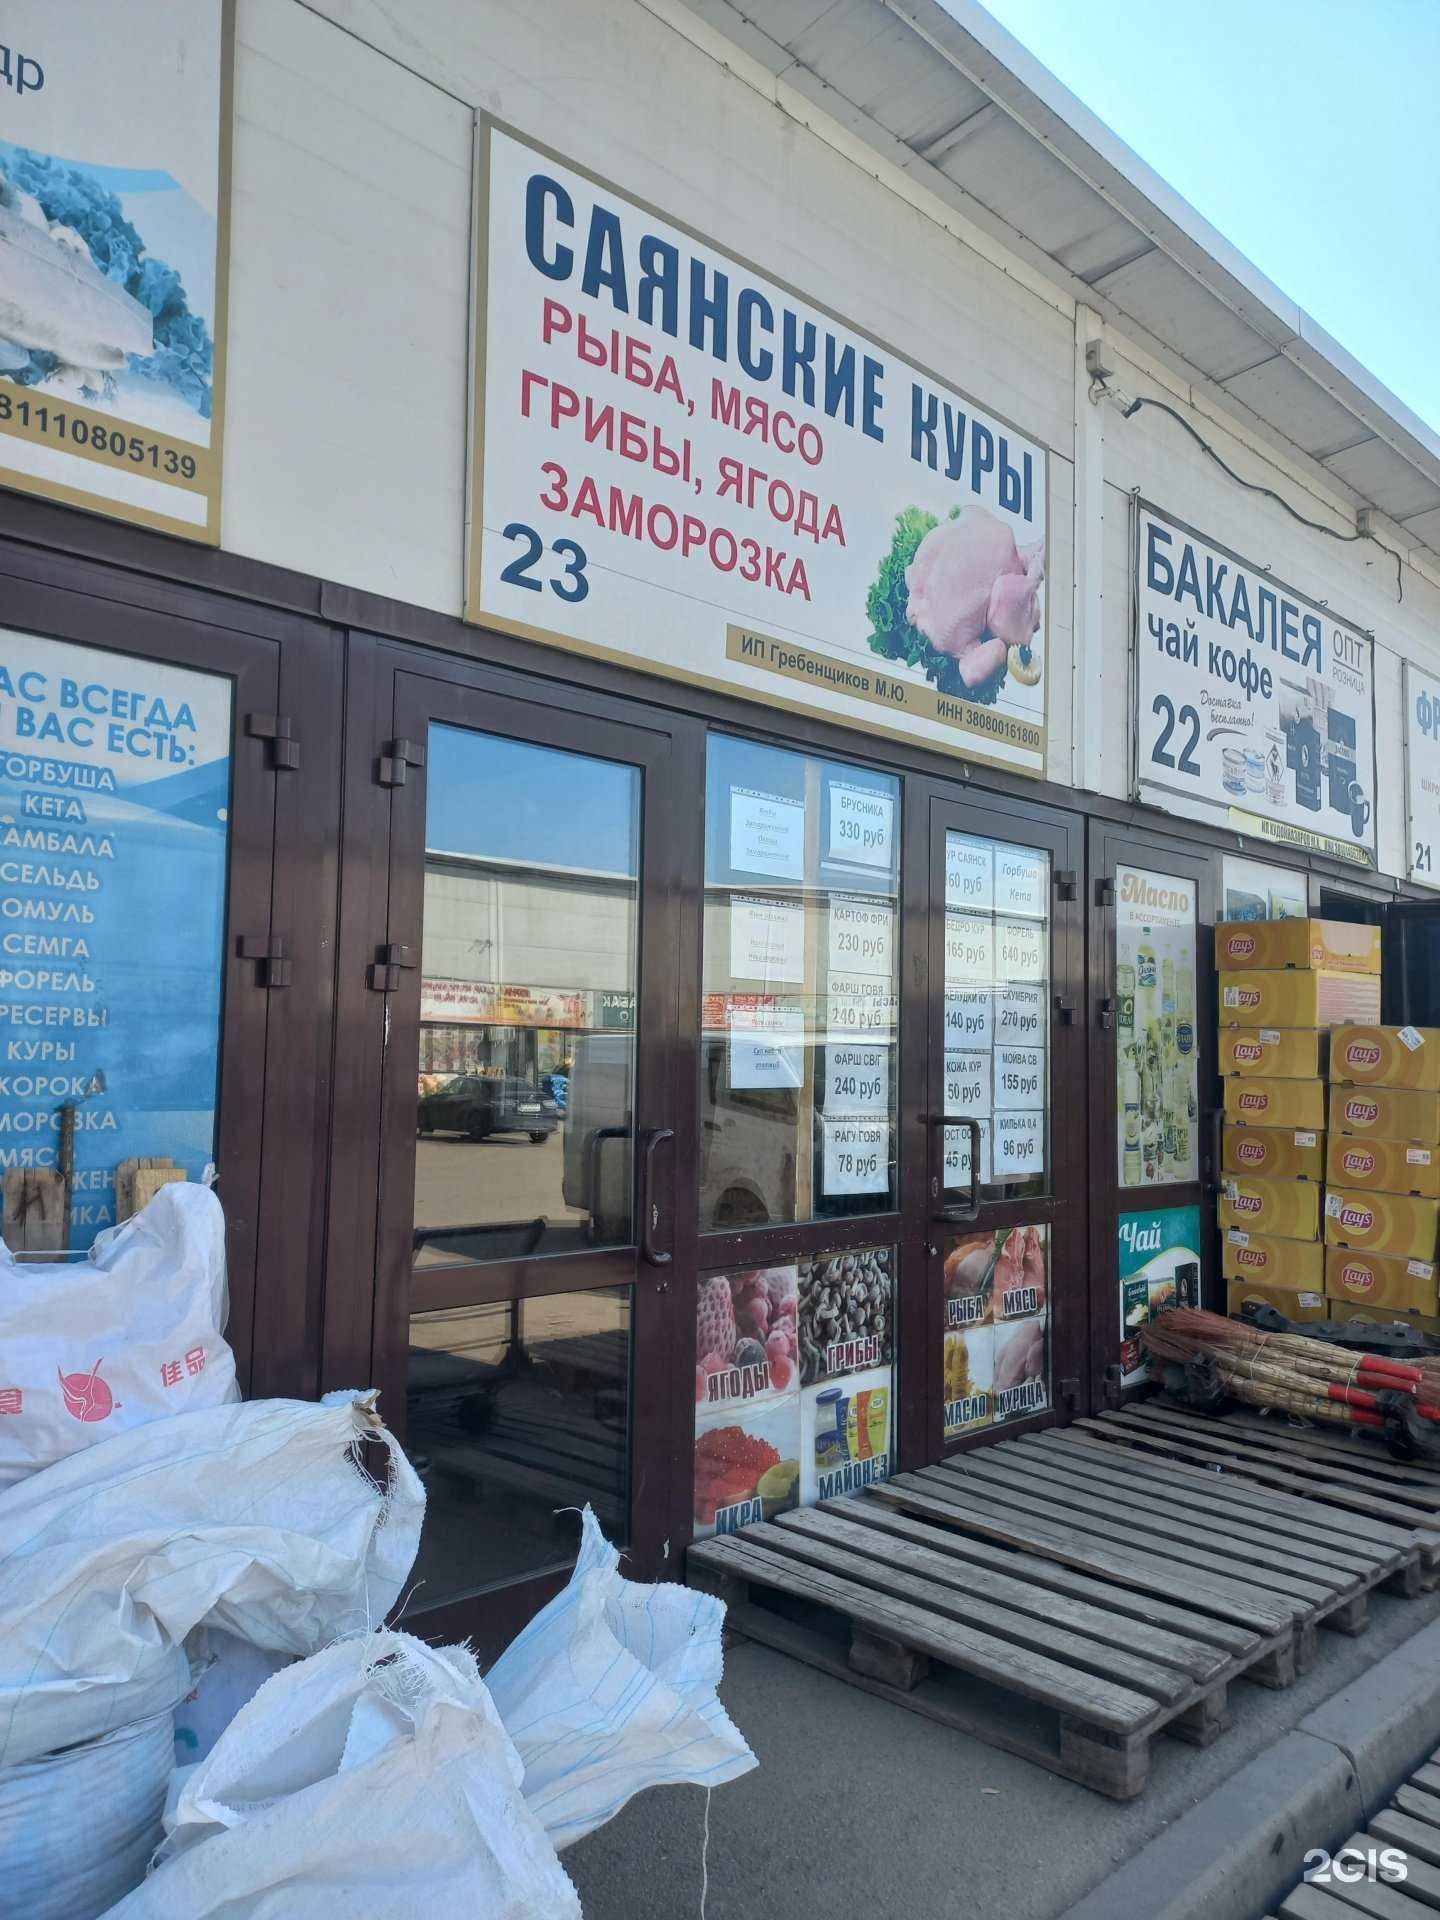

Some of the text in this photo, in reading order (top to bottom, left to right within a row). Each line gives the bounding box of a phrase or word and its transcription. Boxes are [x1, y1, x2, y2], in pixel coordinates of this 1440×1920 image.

[524, 173, 1034, 523] САЯНСКИЕ КУРЫ
[543, 297, 825, 466] РЫБА, МЯСО
[521, 368, 847, 547] ГРИБЫ, ЯГОДА
[539, 461, 812, 602] ЗАМОРОЗКА
[500, 522, 590, 602] 23
[1146, 522, 1322, 674] БАКАЛЕЯ
[1148, 612, 1273, 701] чай кофе
[1333, 629, 1364, 669] ОПТ
[742, 634, 908, 704] ИП Гребенщиков М.Ю.
[1332, 666, 1366, 696] РОЗНИЦА
[59, 678, 197, 732] ВСЕГДА
[937, 699, 963, 722] ИНН
[1200, 689, 1242, 710] Доставка
[15, 706, 196, 766] ВАС ЕСТЬ:
[1151, 694, 1201, 777] 22
[25, 794, 82, 820] КЕТА
[841, 796, 884, 817] БРУСНИКА
[0, 827, 115, 859] АМБАЛА
[839, 819, 884, 848] 330 руб
[1415, 842, 1432, 872] 21
[1, 862, 100, 892] СЕЛЬДЬ
[963, 876, 982, 895] руб
[1121, 873, 1189, 912] Масло
[2, 898, 95, 924] ОМУЛЬ
[3, 933, 90, 958] СЕМГА
[838, 932, 884, 957] 230 руб
[966, 944, 985, 965] руб
[1002, 945, 1038, 967] 640 руб
[832, 982, 859, 994] ФАРШ
[832, 1007, 881, 1029] 240 руб
[946, 1010, 985, 1034] 140 руб
[1001, 1009, 1037, 1031] 270 руб
[8, 1040, 75, 1061] КУРЫ
[835, 1053, 861, 1066] ФАРШ
[1028, 1054, 1038, 1066] СВ
[835, 1076, 881, 1099] 240 руб
[962, 1082, 981, 1103] руб
[1001, 1073, 1038, 1094] 155 руб
[835, 1130, 881, 1143] РАГУ ГОВЯ
[1003, 1139, 1034, 1159] 96 руб
[0, 1147, 76, 1168] МЯС
[838, 1154, 877, 1176] 78 руб
[961, 1153, 973, 1171] ру
[1119, 1220, 1162, 1252] Чай
[949, 1297, 984, 1324] РЫБА
[1003, 1288, 1037, 1315] МЯСО
[827, 1336, 879, 1373] ГРИБЫ
[707, 1362, 770, 1402] ЯГОДЫ
[944, 1396, 986, 1426] МАСЛО
[999, 1382, 1044, 1414] КУРИЦА
[818, 1454, 889, 1500] МАЙОНЕЗ
[715, 1498, 763, 1536] ИКРА
